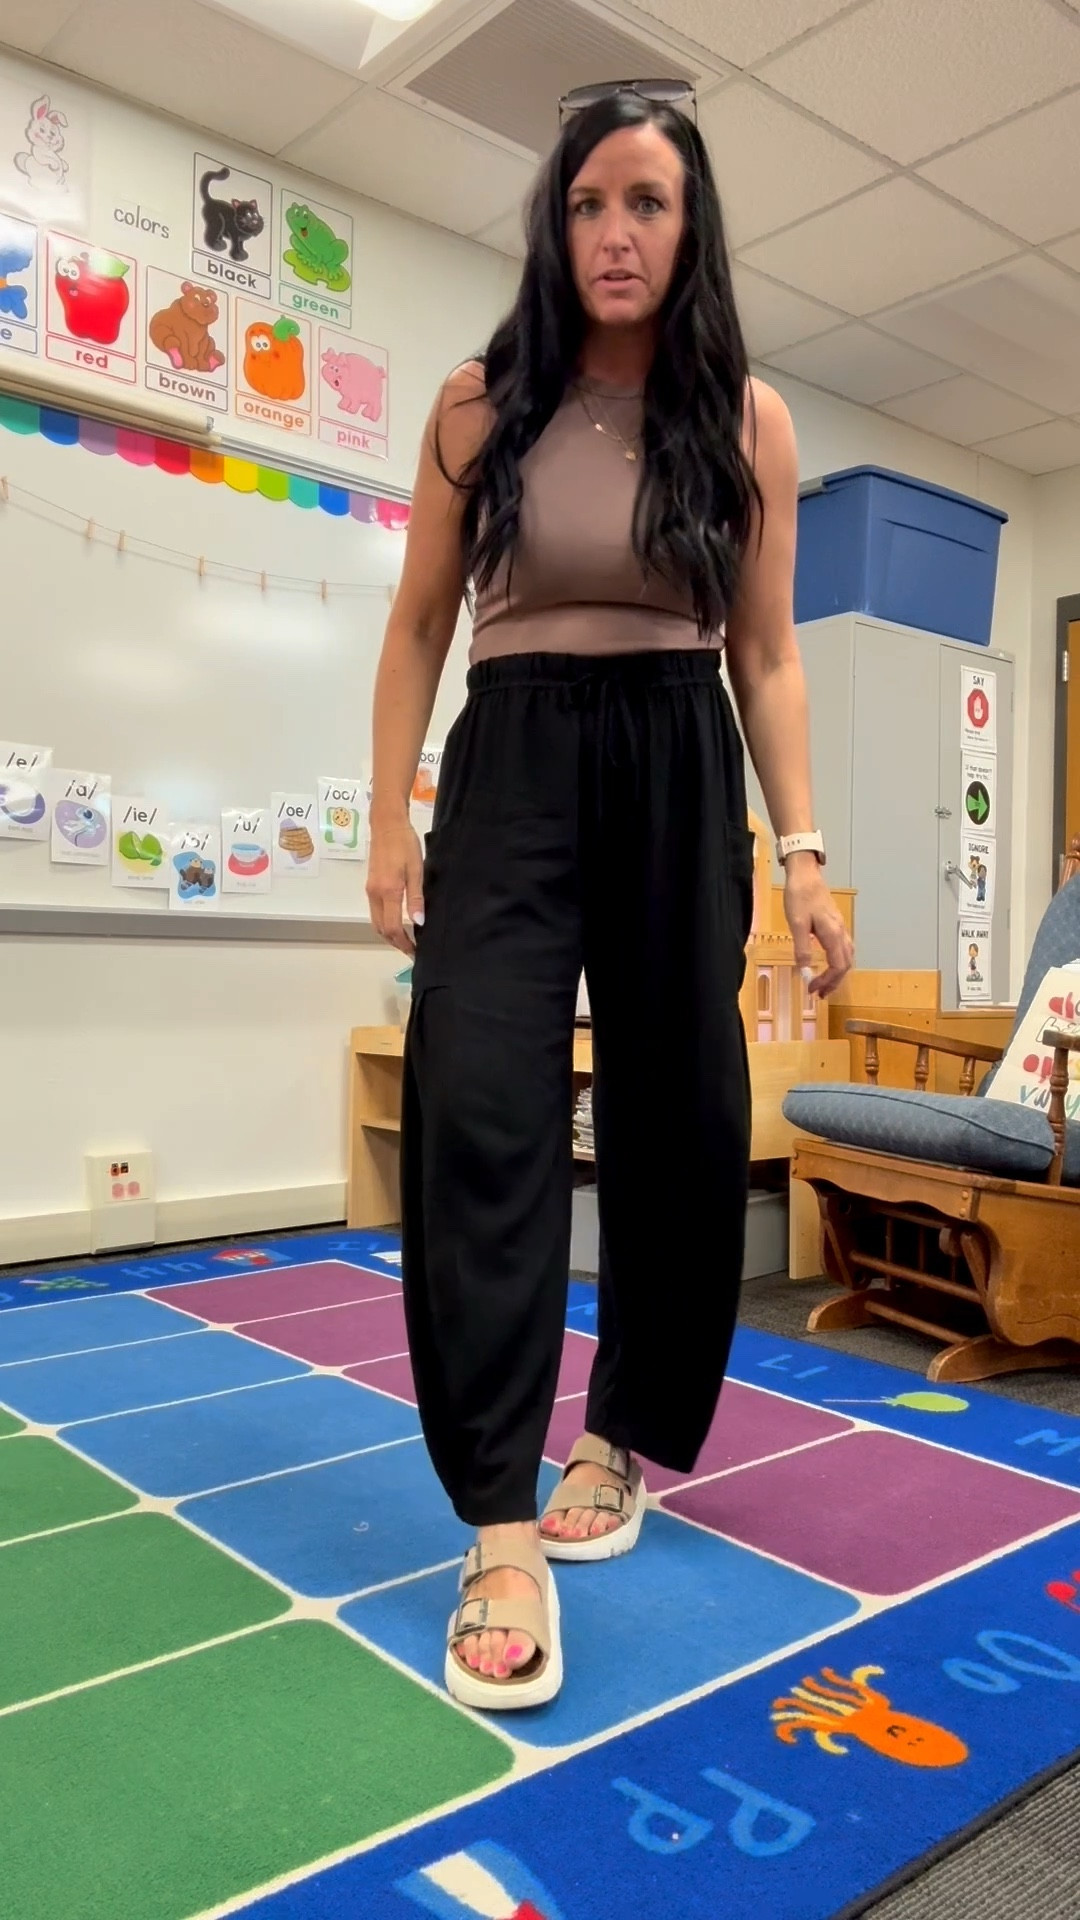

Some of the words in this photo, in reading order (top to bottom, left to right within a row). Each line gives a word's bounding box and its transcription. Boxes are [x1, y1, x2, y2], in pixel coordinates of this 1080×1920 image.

[113, 205, 170, 239] colors
[206, 259, 257, 289] black
[292, 293, 339, 319] green
[75, 350, 108, 369] red
[158, 372, 216, 402] brown
[243, 400, 305, 428] orange
[337, 428, 370, 450] pink
[972, 675, 985, 686] SAY
[65, 779, 98, 800] /a/
[122, 806, 158, 825] /ie/
[277, 801, 313, 820] /oe/
[233, 815, 261, 834] /u/
[968, 842, 990, 854] IGNORE
[961, 929, 976, 938] WALK
[976, 930, 989, 939] AWAY
